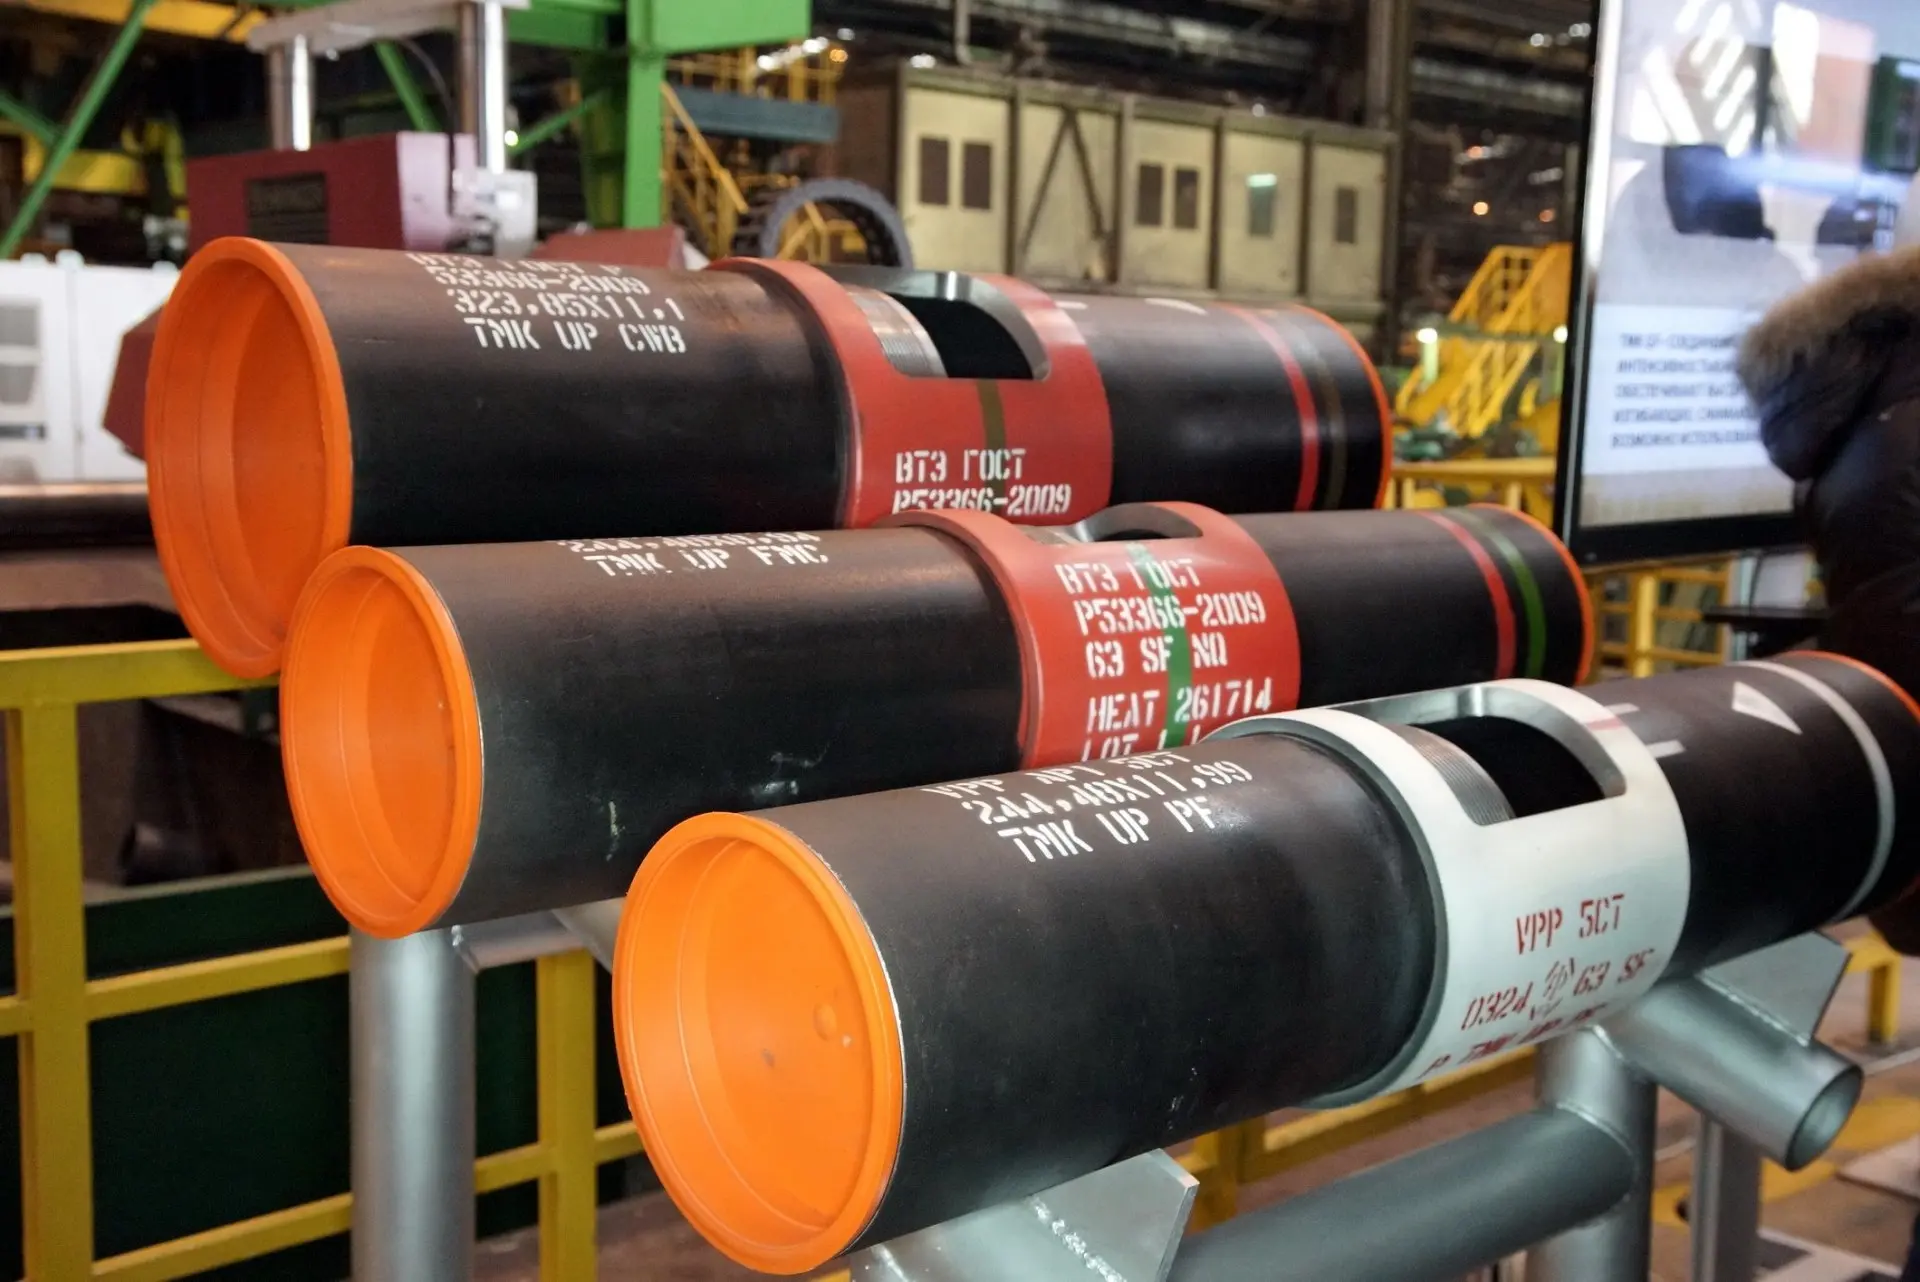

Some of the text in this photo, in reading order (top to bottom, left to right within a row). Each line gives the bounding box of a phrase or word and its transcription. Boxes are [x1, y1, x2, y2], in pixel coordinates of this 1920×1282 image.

[425, 265, 651, 295] 53366-2009
[464, 317, 541, 350] TMK
[553, 320, 598, 351] UP
[963, 448, 1026, 481] ГОСТ
[1140, 635, 1174, 673] SF
[1087, 676, 1273, 733] HEAT 261714
[997, 796, 1216, 863] TMK UP PF
[1516, 894, 1625, 955] VPP 5CT
